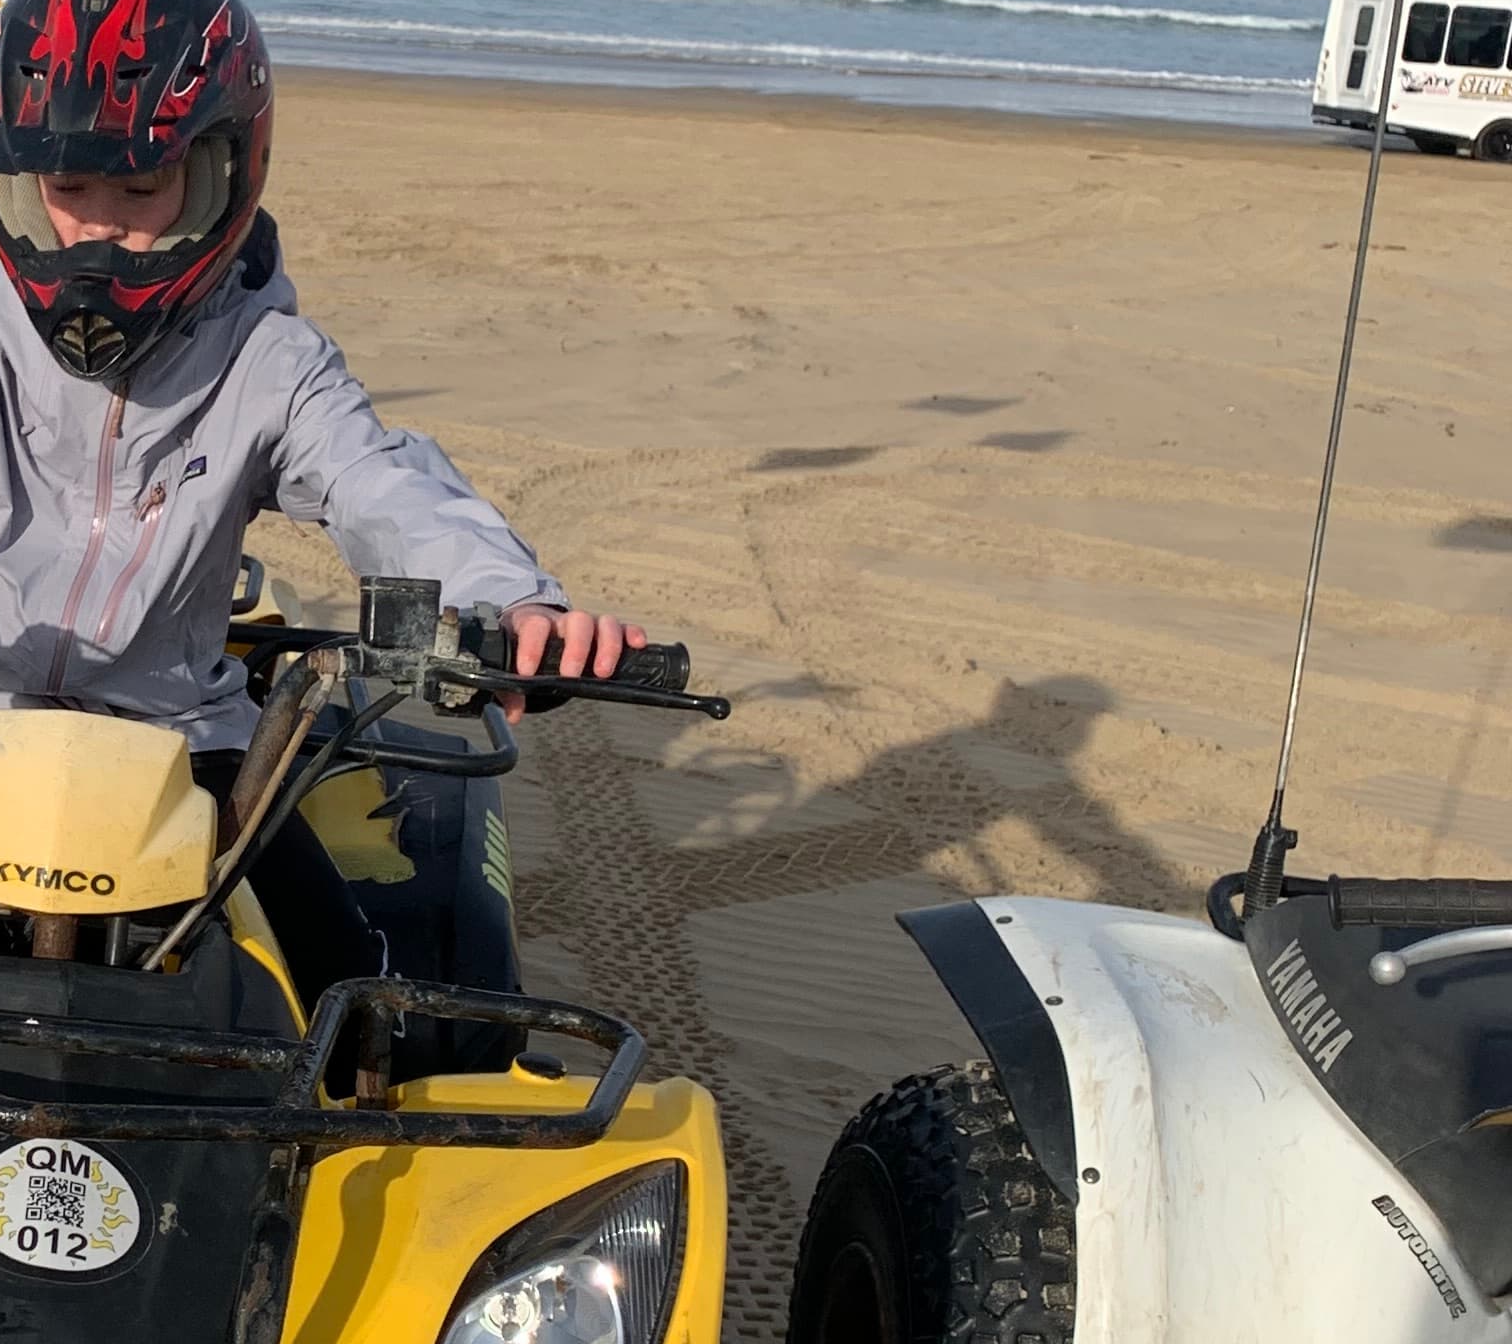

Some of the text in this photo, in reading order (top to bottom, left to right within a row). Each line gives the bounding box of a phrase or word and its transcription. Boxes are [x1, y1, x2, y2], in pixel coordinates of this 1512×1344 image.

[1266, 938, 1354, 1074] YAMAHA
[26, 1146, 91, 1179] QM
[17, 1225, 88, 1261] 012
[1371, 1194, 1467, 1320] AUTOMATIC
